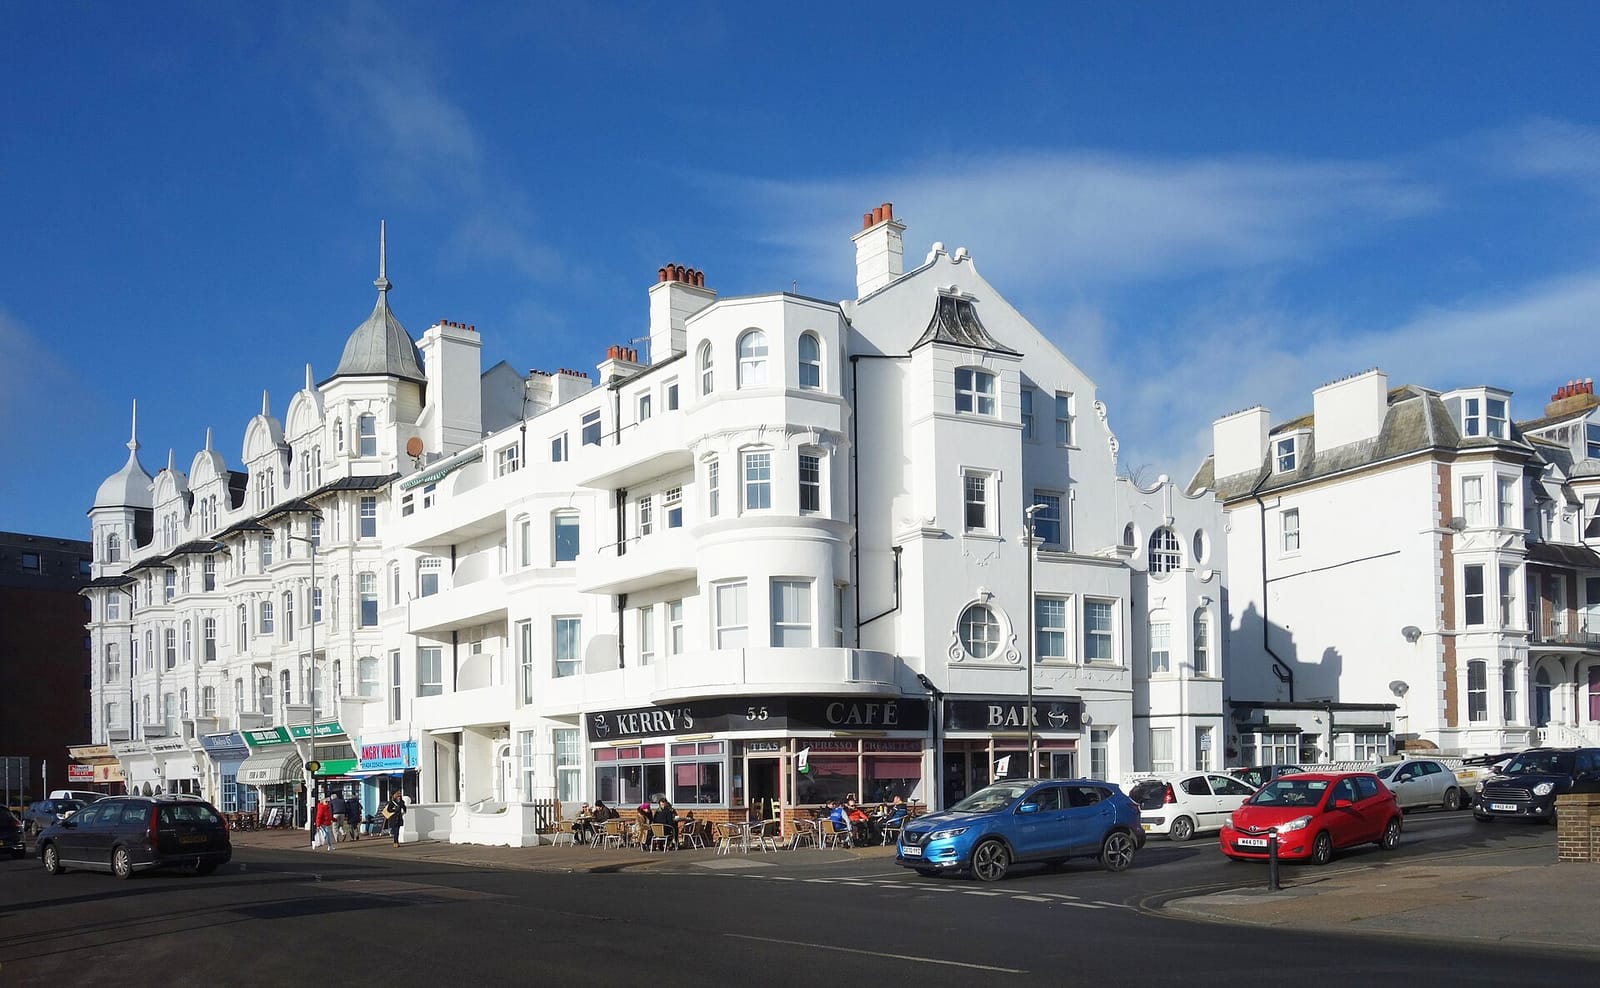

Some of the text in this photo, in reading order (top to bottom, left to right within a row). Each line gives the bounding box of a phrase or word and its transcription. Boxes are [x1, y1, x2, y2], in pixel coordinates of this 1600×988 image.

[616, 707, 694, 735] KERRY'S
[745, 706, 769, 721] 55
[826, 701, 898, 725] CAFÉ
[988, 705, 1039, 727] BAR
[362, 745, 379, 760] ANGRY
[381, 743, 401, 759] WHELK
[751, 742, 779, 751] TEAS
[802, 741, 853, 750] ESPRESSO
